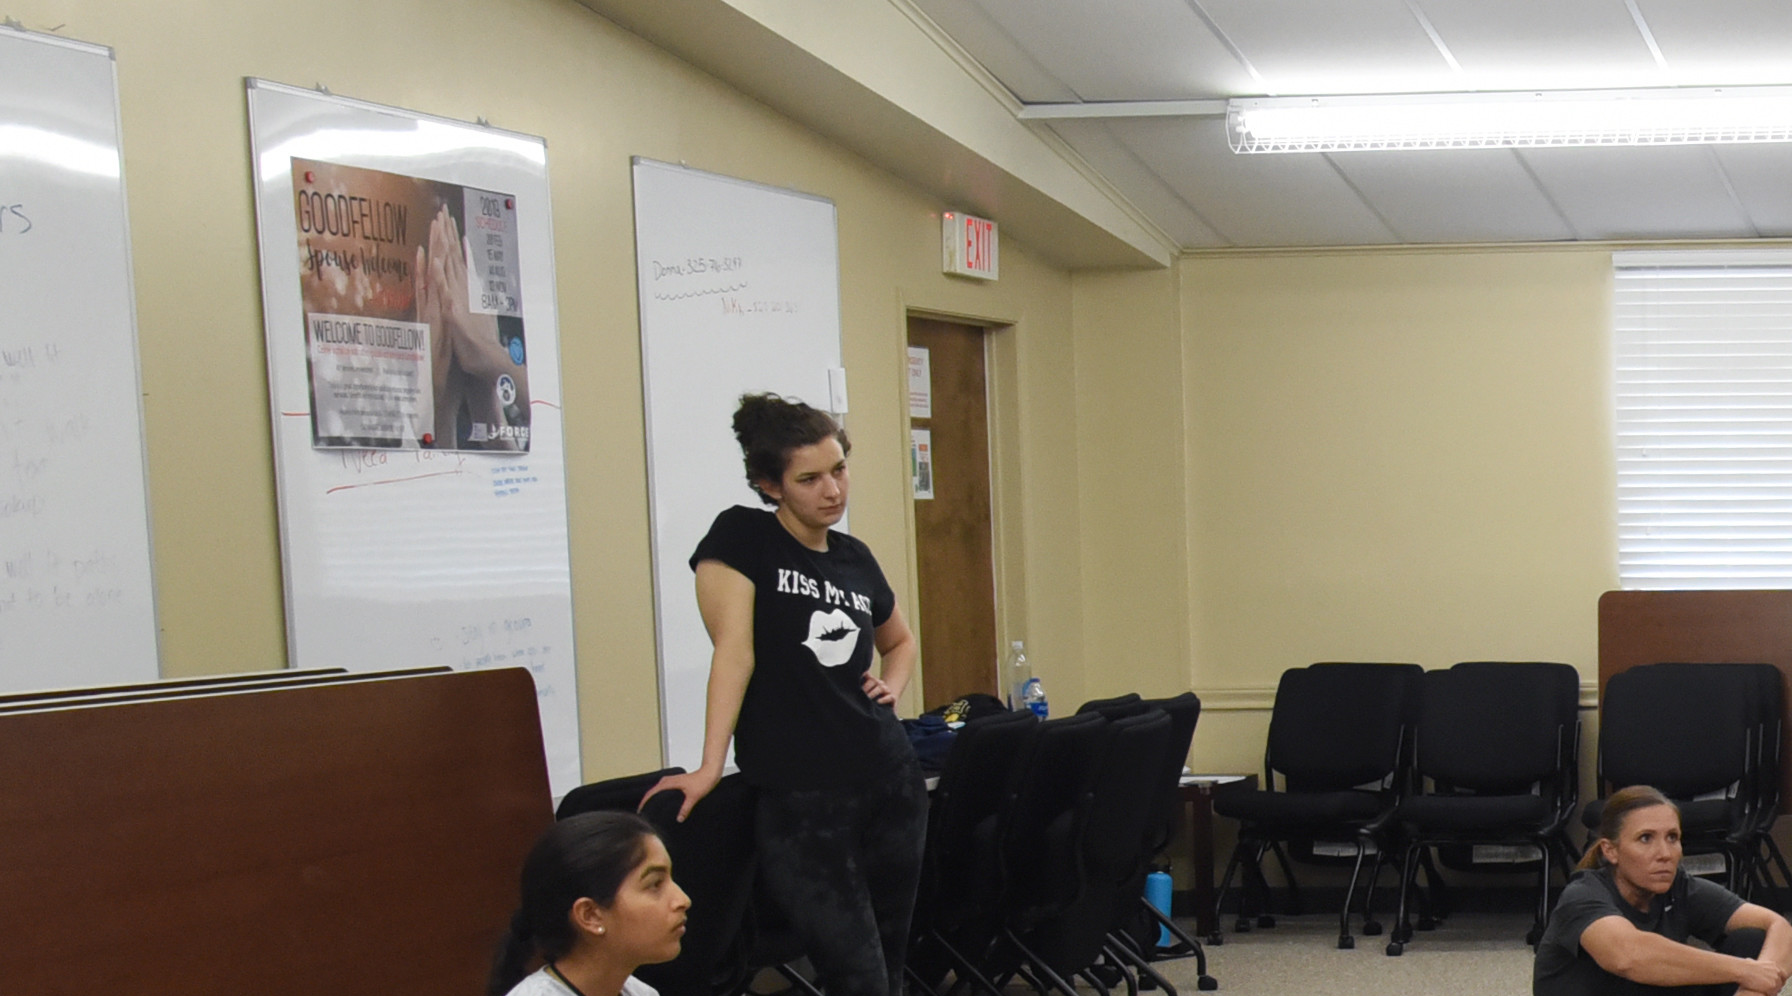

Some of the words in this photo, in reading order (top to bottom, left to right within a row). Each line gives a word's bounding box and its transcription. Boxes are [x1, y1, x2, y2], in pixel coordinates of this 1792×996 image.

[297, 190, 409, 246] GOODFELLOW
[966, 217, 993, 273] EXIT
[312, 320, 362, 345] WELCOME
[362, 322, 375, 346] TO
[776, 567, 821, 600] KISS
